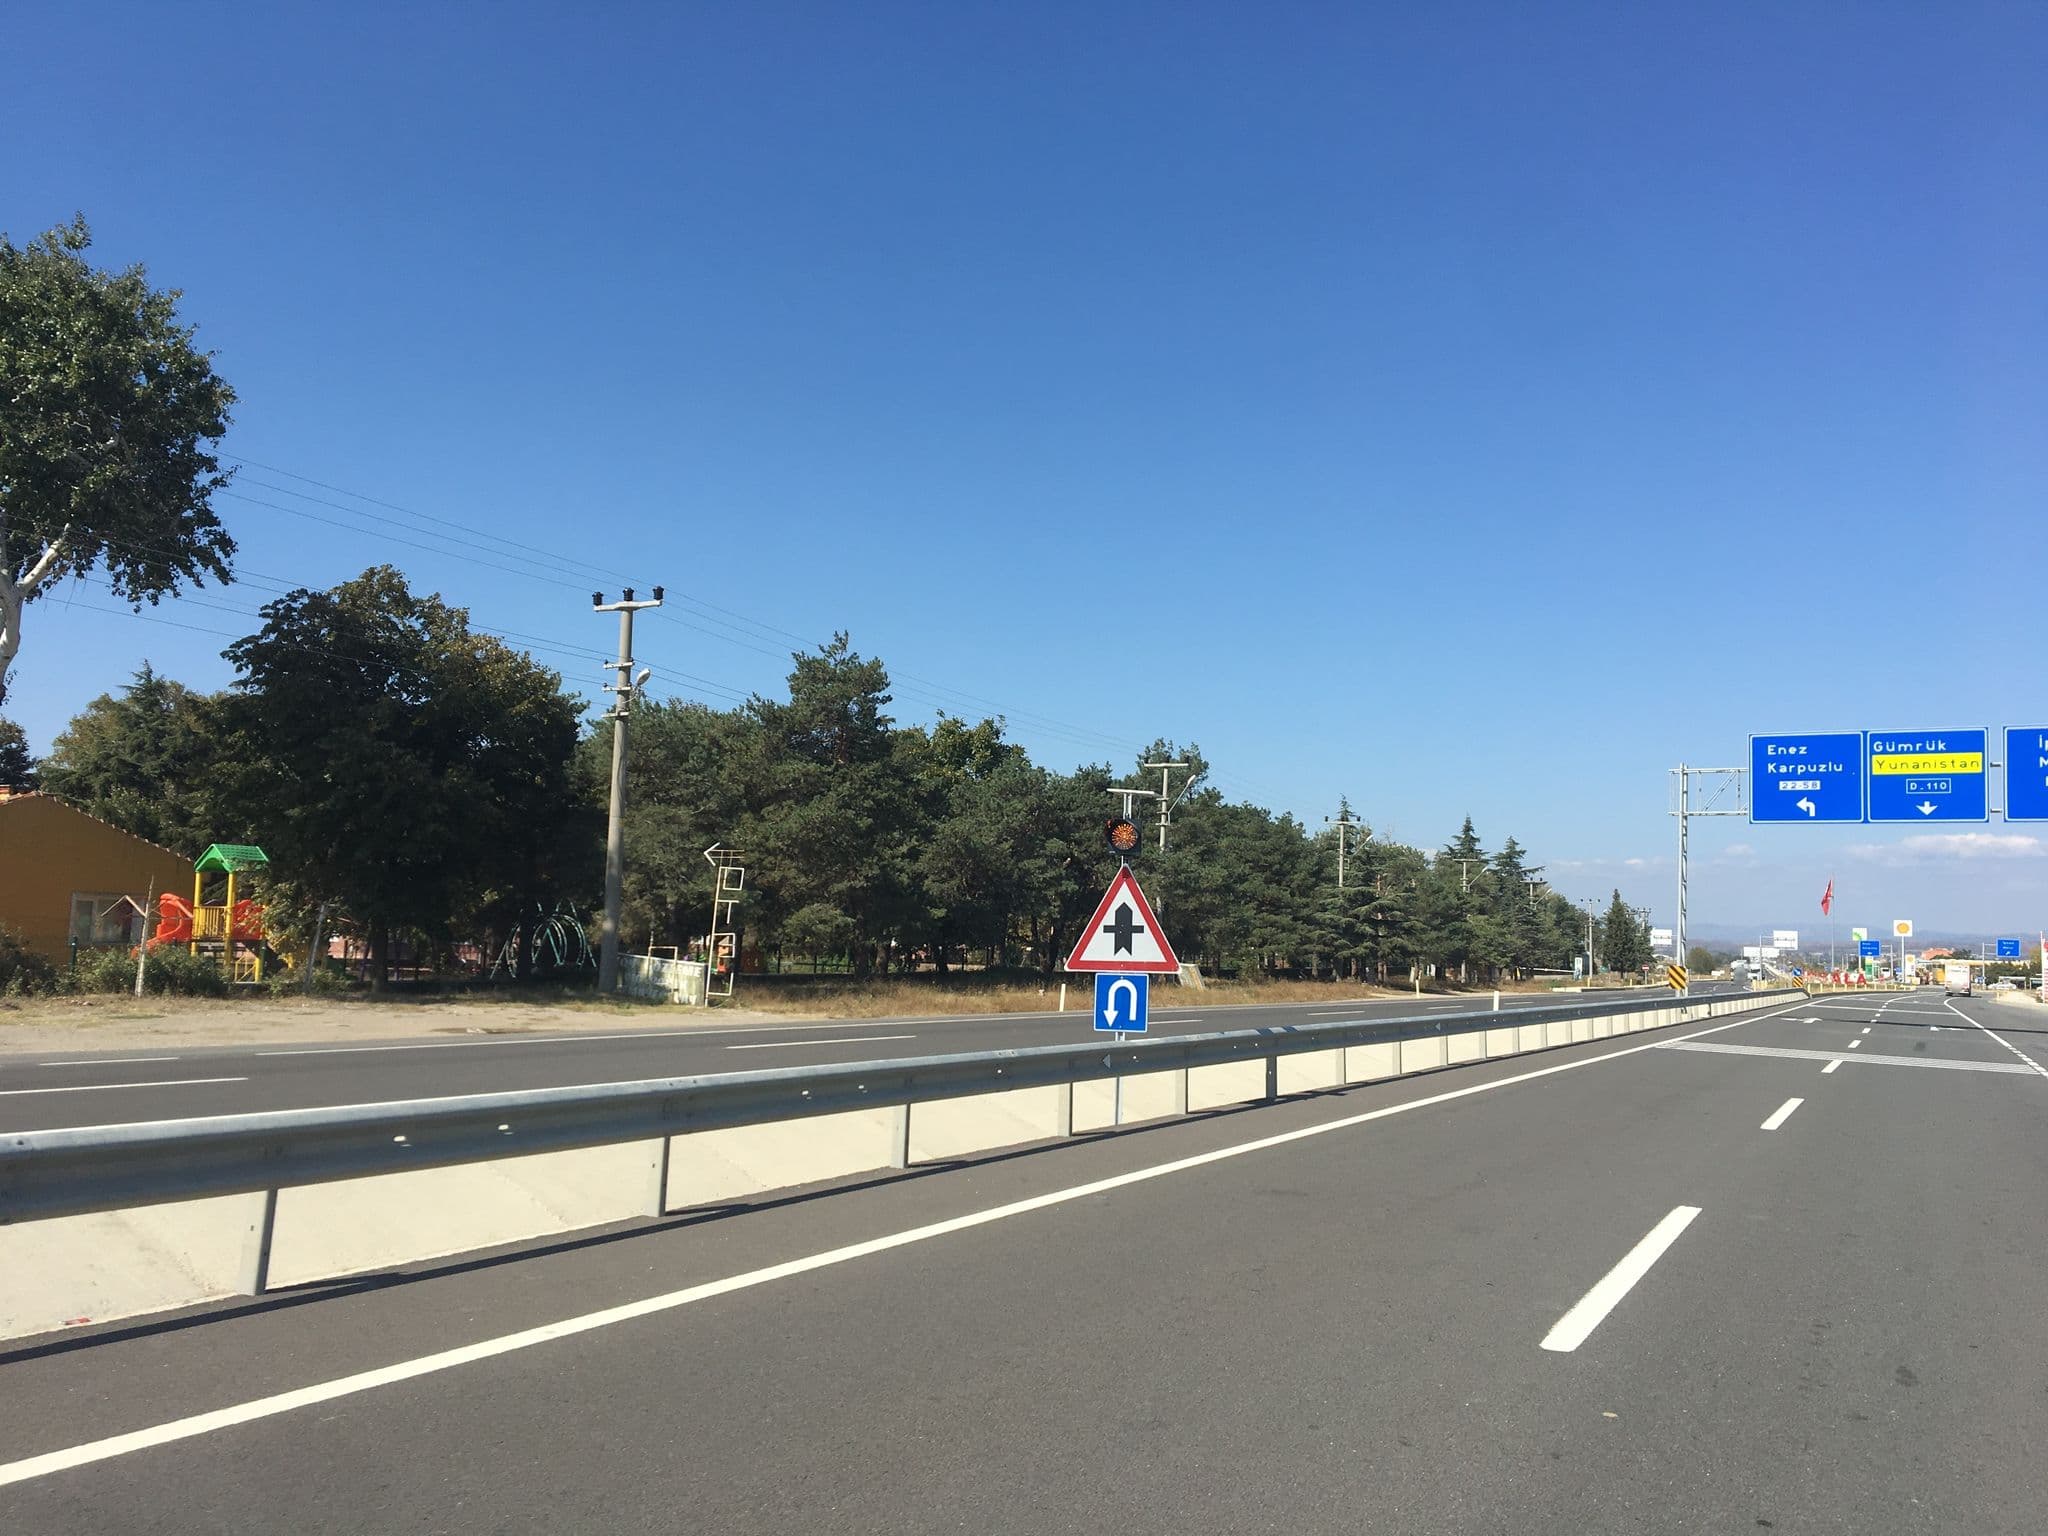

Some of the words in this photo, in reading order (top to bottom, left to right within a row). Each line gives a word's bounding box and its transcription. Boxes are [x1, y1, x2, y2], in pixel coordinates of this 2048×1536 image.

[1767, 744, 1808, 755] Enez
[1873, 739, 1947, 752] Gümrük
[1767, 761, 1843, 775] Karpuzlu
[1875, 758, 1980, 770] Yunanistan
